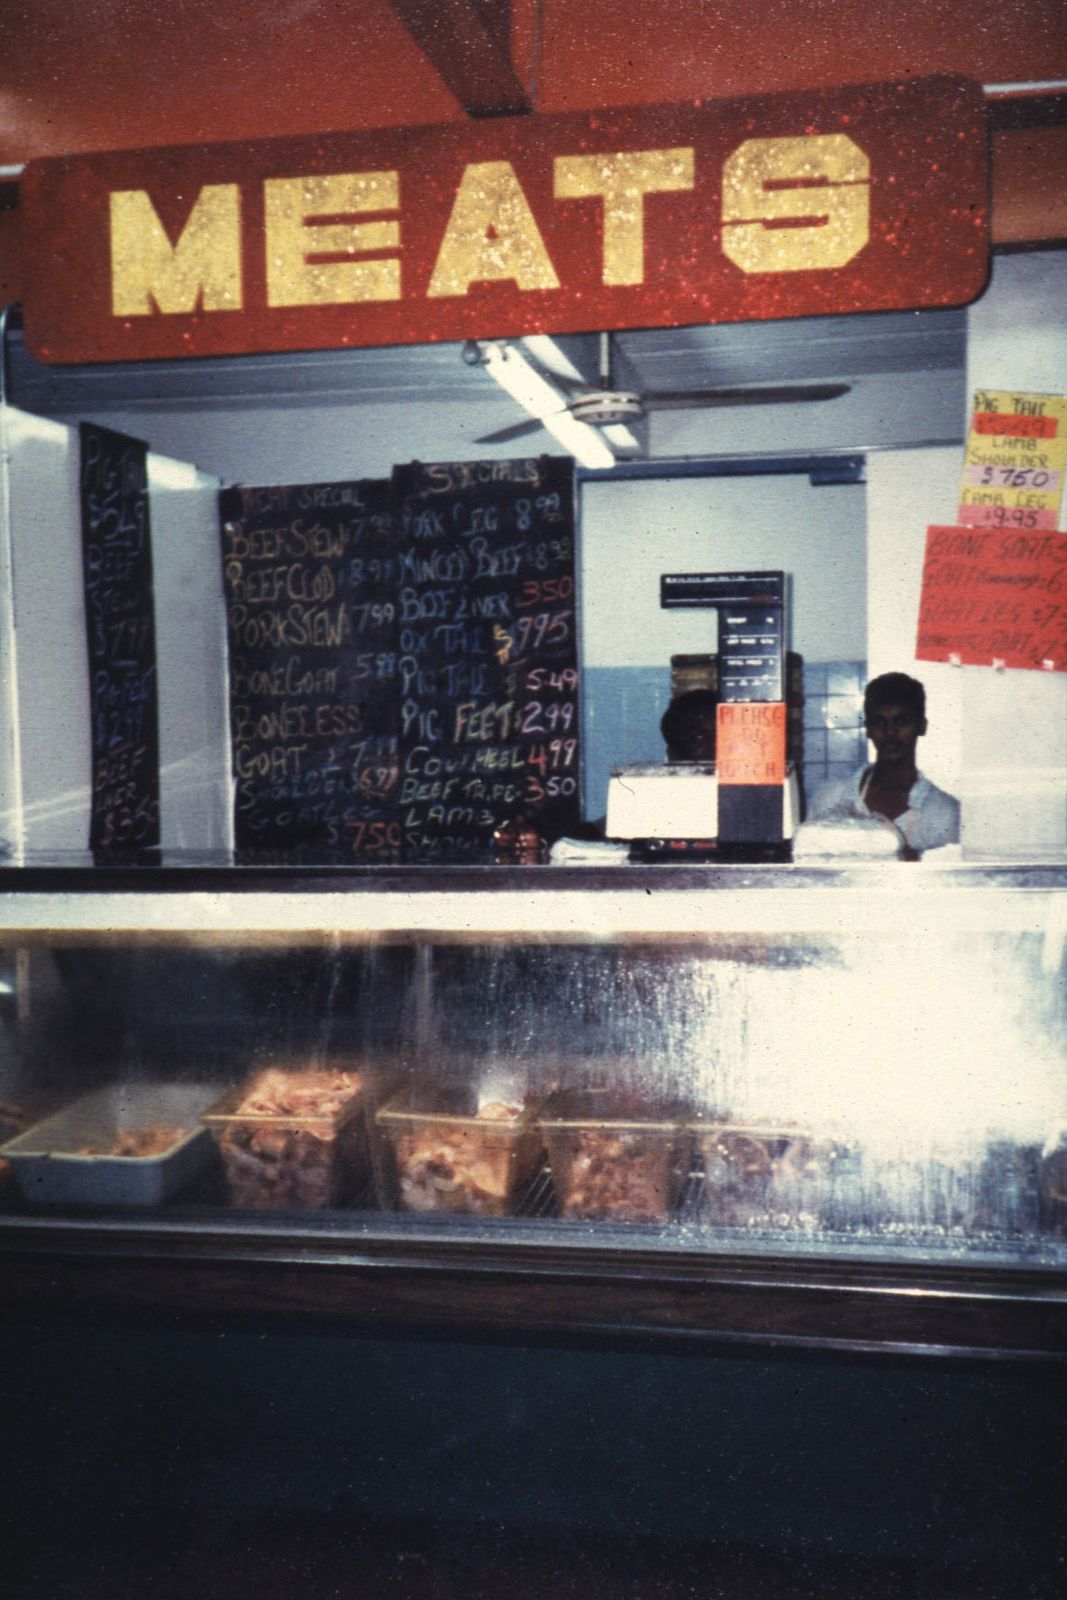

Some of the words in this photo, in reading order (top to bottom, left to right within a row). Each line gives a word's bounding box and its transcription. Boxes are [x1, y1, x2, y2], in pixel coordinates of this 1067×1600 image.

[109, 133, 870, 317] MEATS
[992, 437, 1038, 451] LAMB
[453, 699, 516, 744] FEET
[236, 743, 308, 780] GOAT
[399, 778, 461, 805] BEEF
